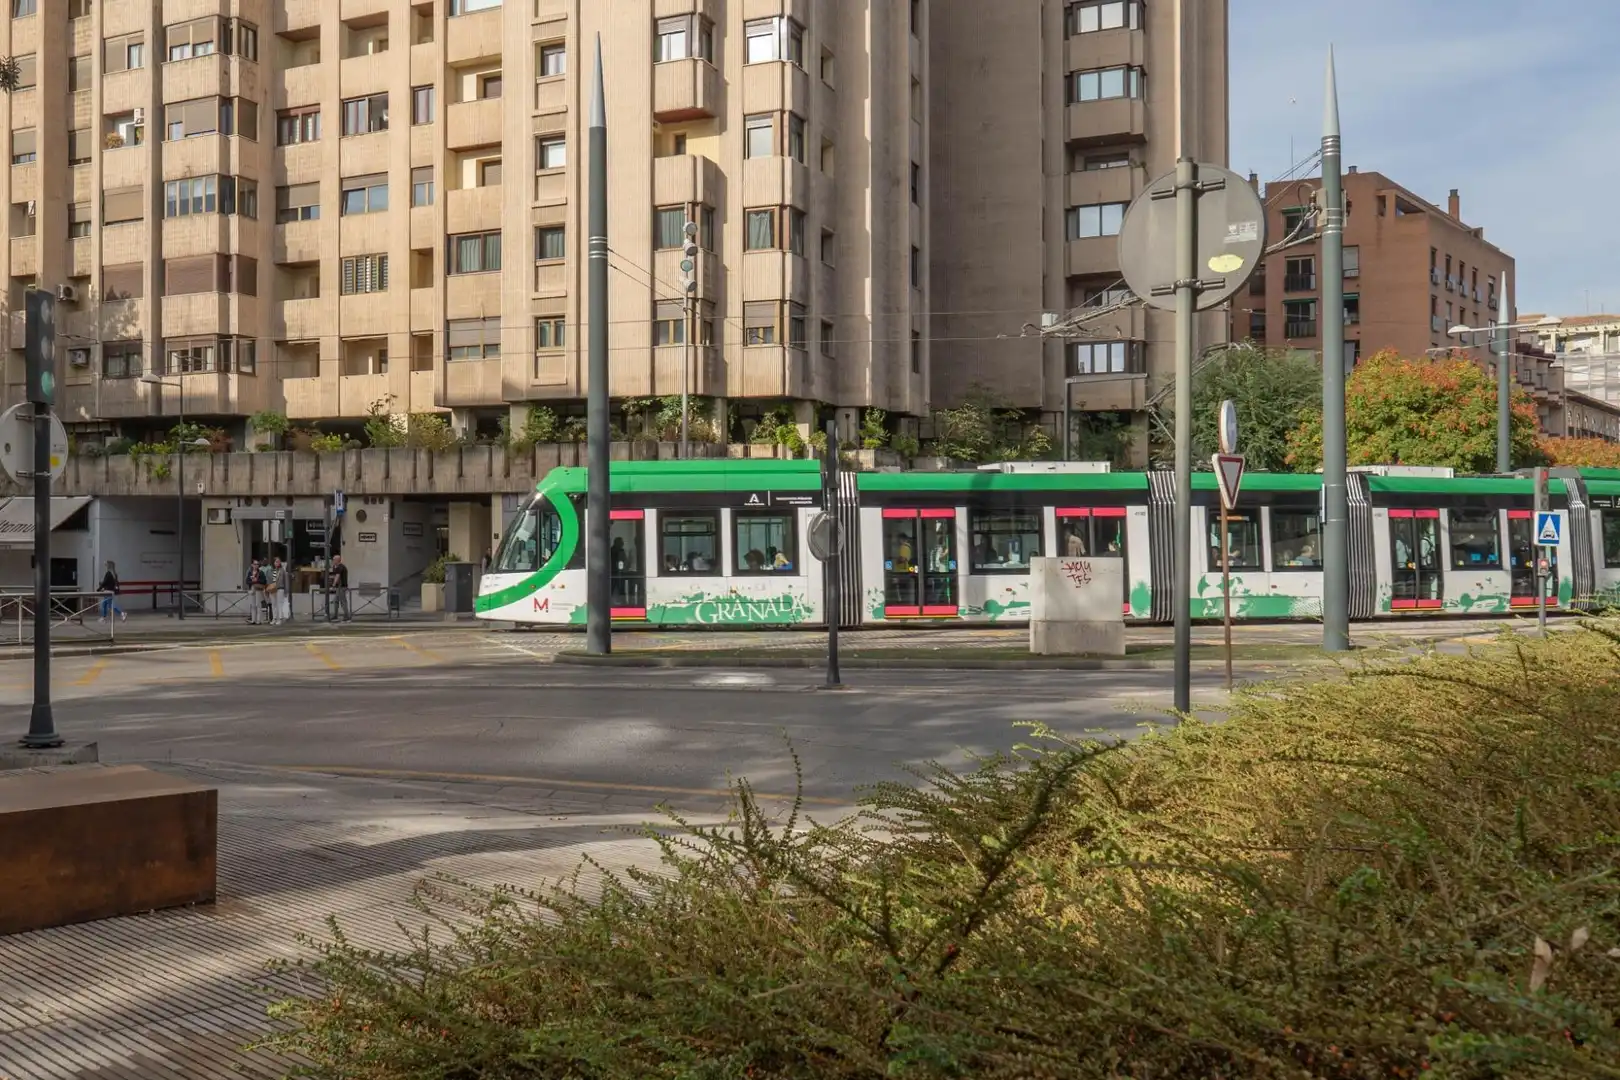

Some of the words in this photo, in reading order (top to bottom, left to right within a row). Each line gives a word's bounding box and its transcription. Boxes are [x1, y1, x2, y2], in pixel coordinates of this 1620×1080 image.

[749, 493, 760, 503] A
[533, 597, 549, 612] M
[694, 596, 805, 624] GRANADA
